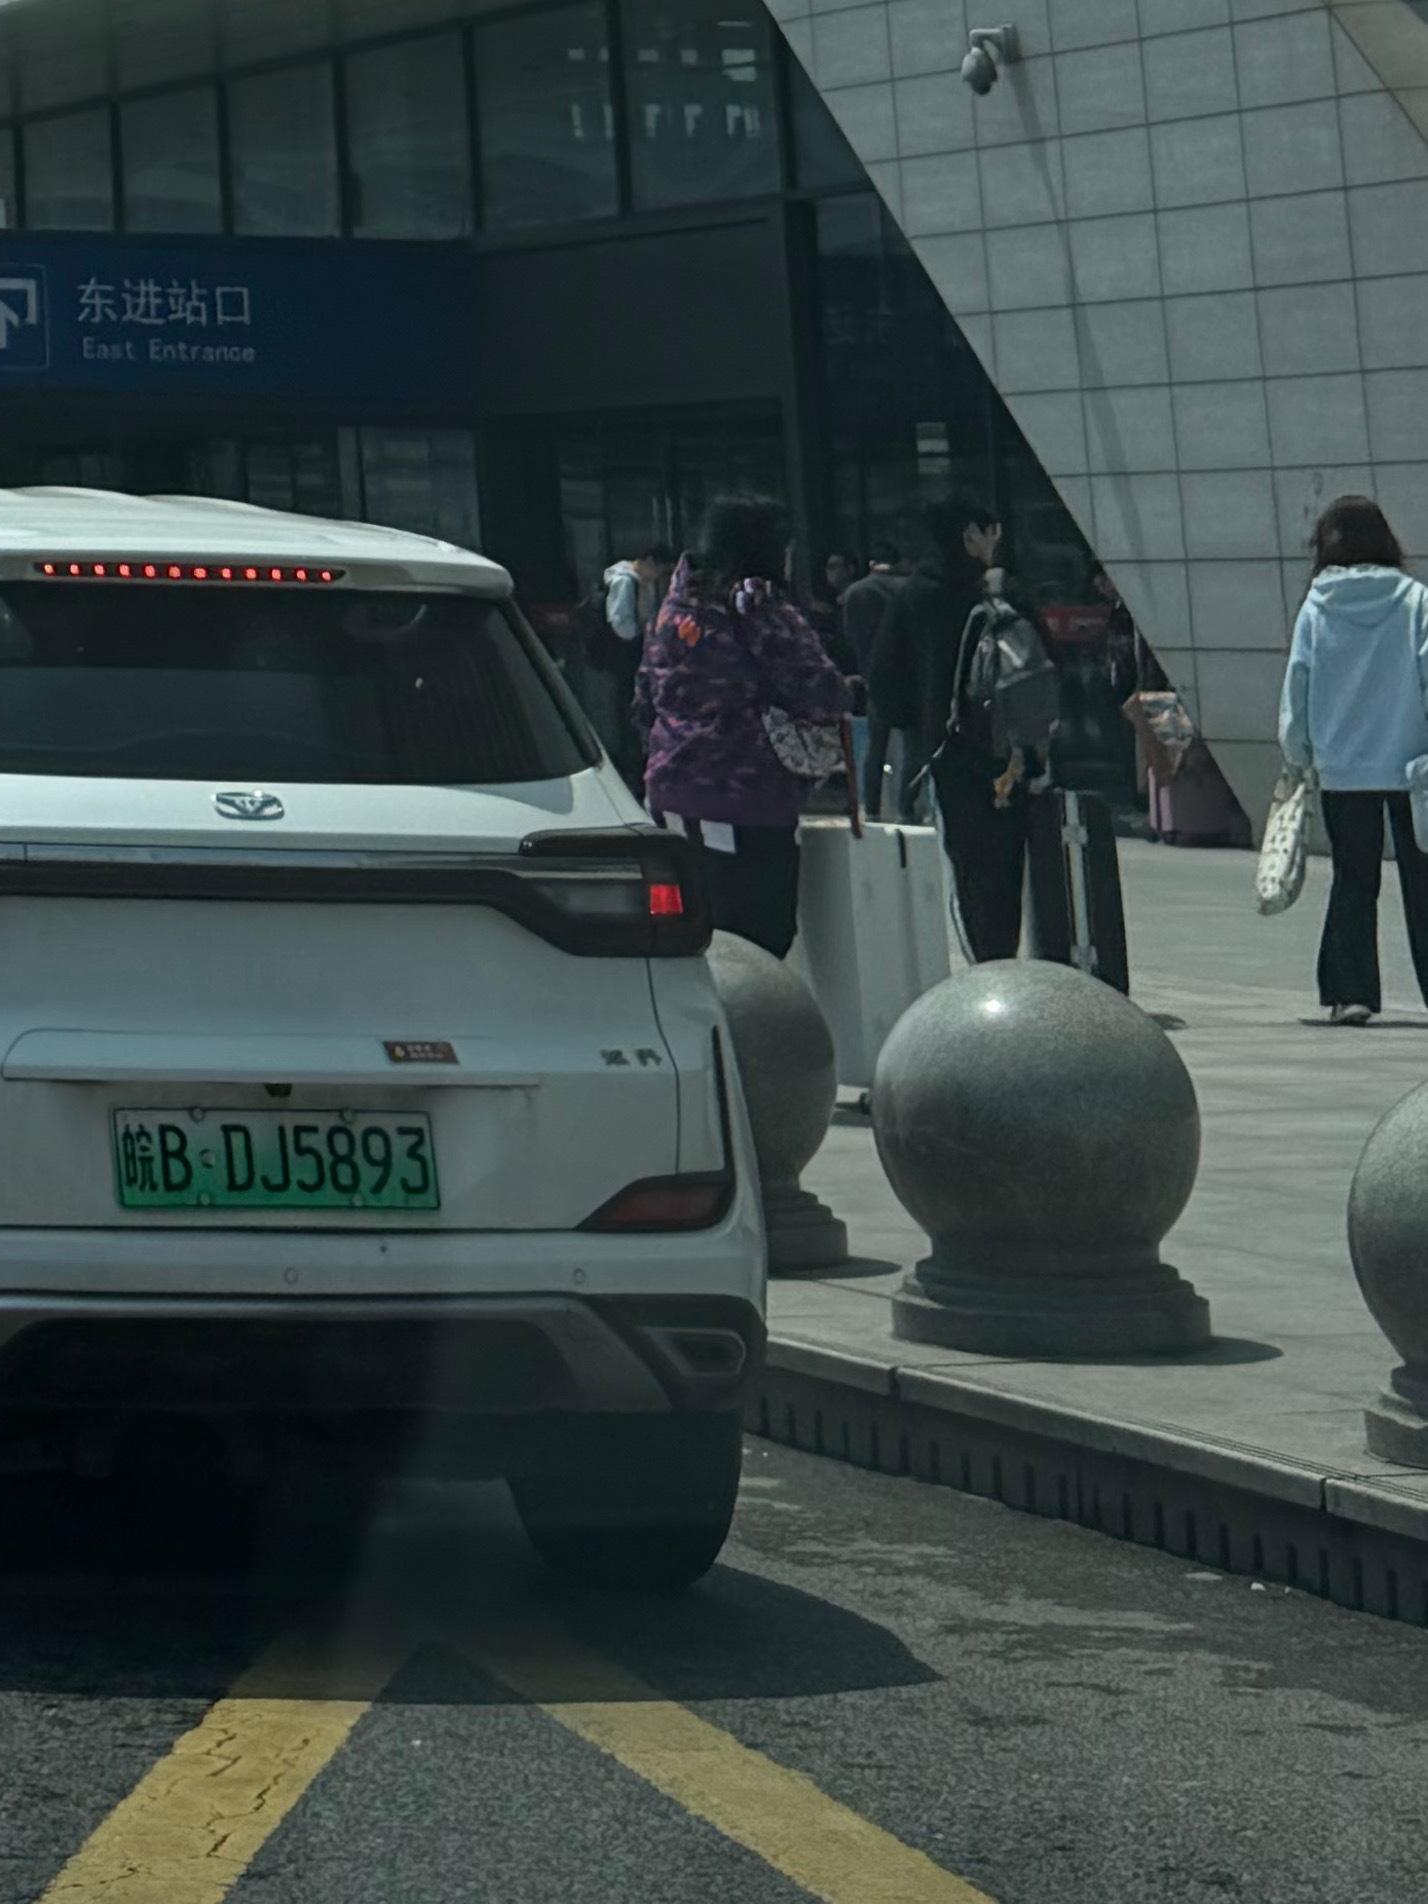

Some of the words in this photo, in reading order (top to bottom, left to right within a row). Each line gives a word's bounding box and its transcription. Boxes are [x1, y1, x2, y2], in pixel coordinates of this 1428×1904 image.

[77, 277, 251, 326] 东进站口
[82, 336, 136, 360] East
[149, 338, 256, 363] Entrance
[220, 1122, 431, 1196] DJ5893
